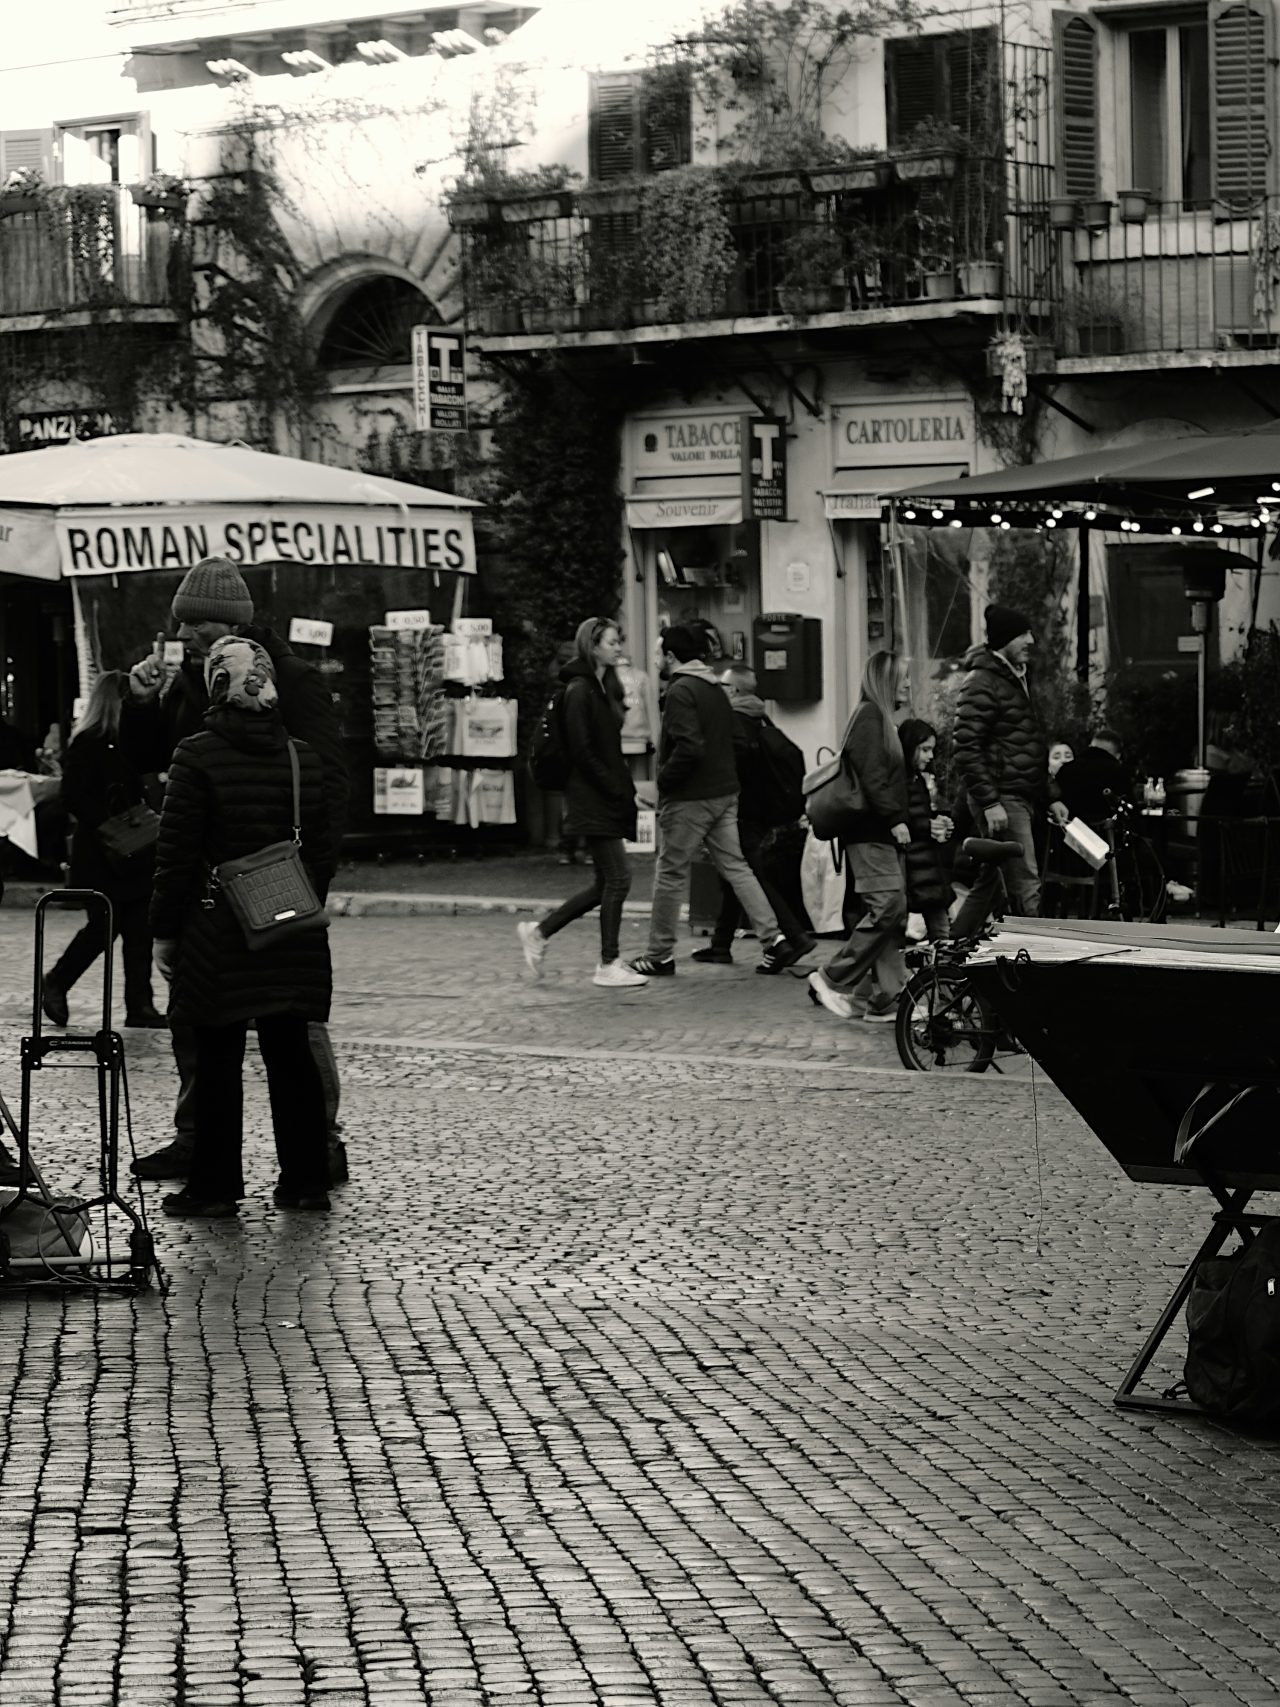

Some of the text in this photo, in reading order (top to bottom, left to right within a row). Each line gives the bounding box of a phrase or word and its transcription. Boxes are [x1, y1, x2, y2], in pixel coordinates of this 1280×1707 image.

[431, 338, 459, 382] T
[416, 333, 426, 426] TABACCHI
[431, 393, 464, 406] TABACCHI
[664, 422, 741, 448] TABACC
[846, 416, 965, 445] CARTOLERIA
[671, 448, 741, 462] VALORI BOLLA
[753, 425, 779, 480] T
[753, 488, 782, 496] TABACCHI
[656, 499, 718, 518] Souvenir
[67, 519, 466, 570] ROMAN SPECIALITIES
